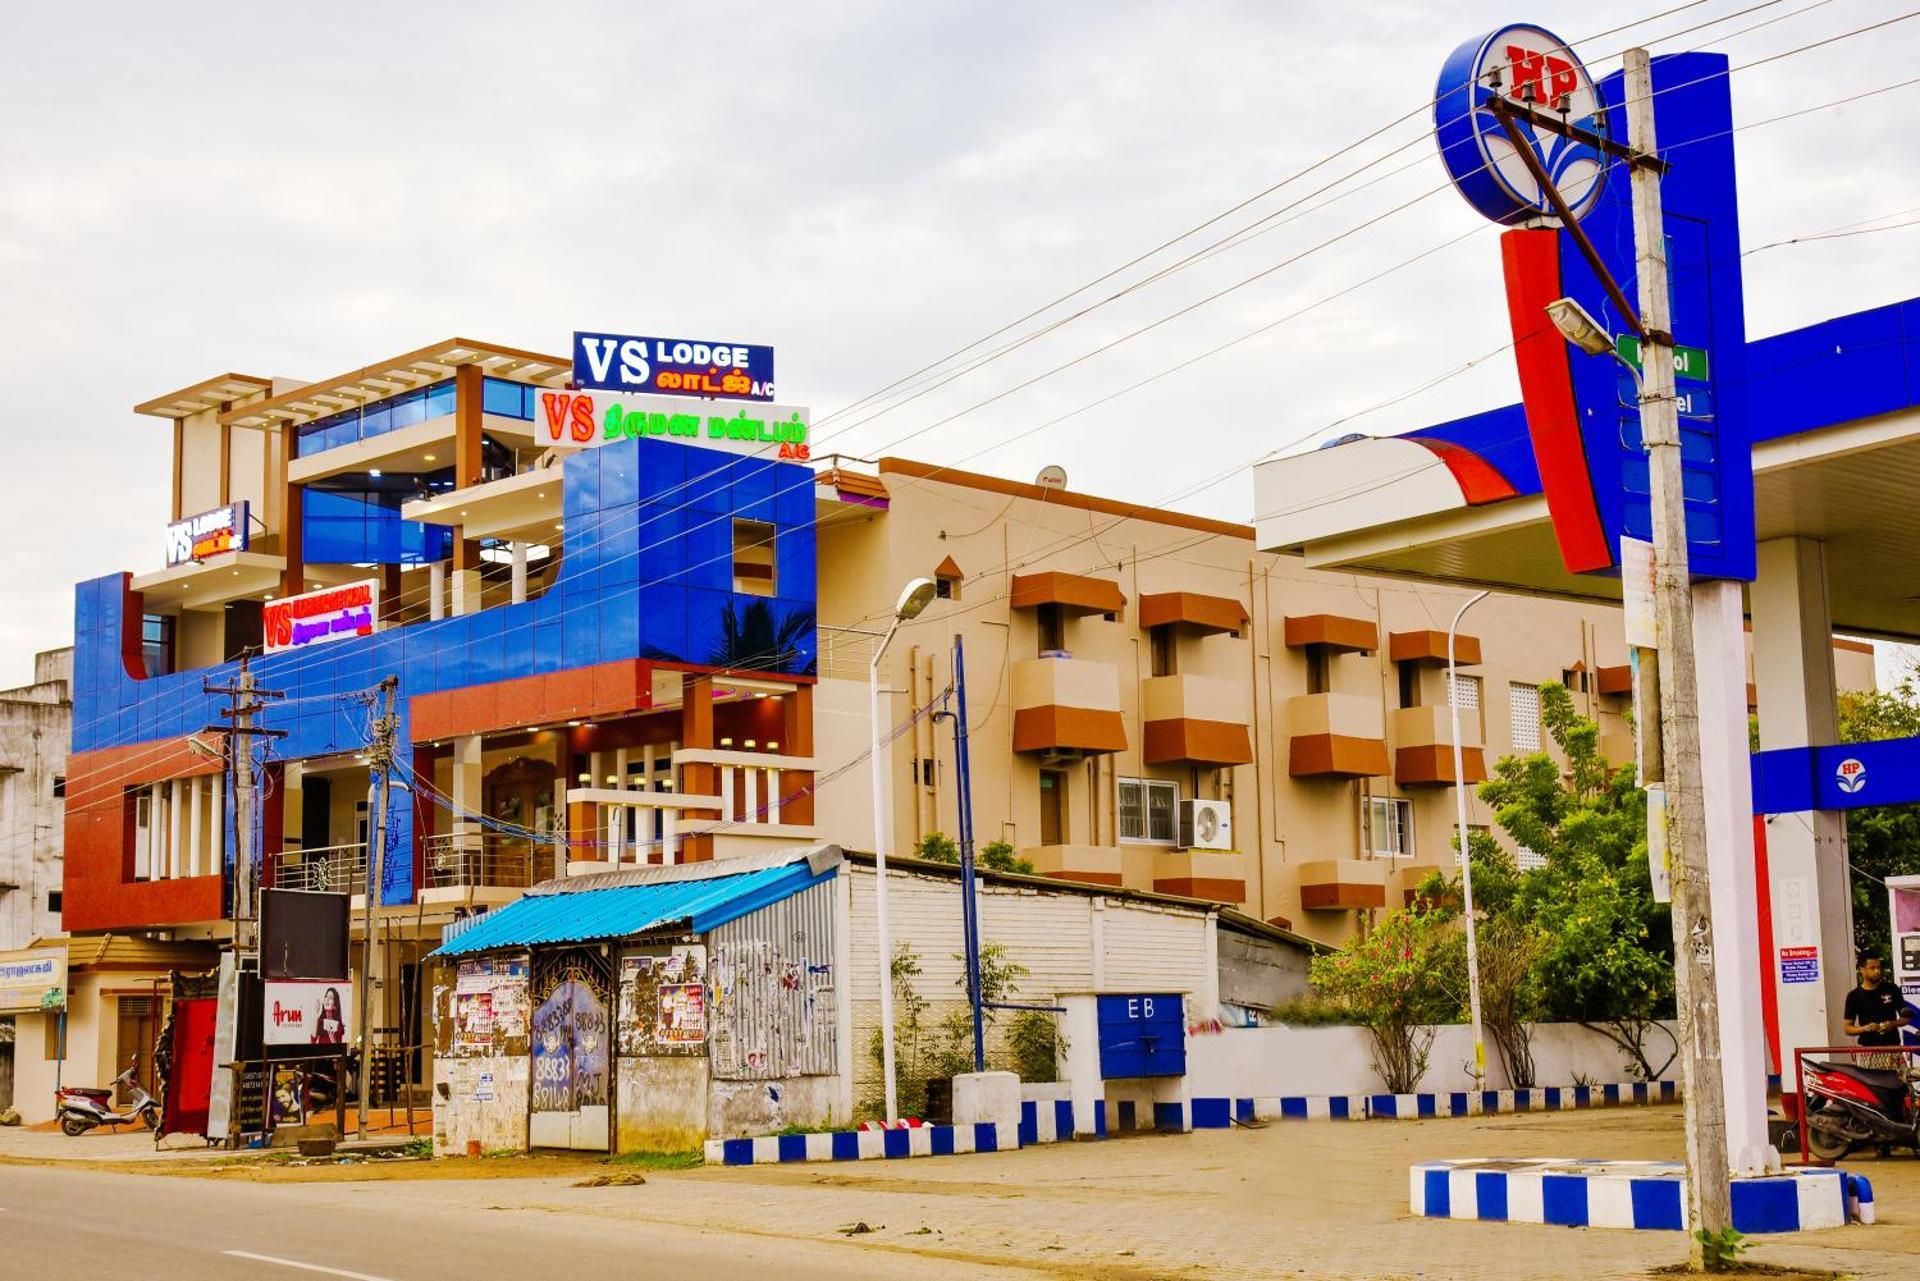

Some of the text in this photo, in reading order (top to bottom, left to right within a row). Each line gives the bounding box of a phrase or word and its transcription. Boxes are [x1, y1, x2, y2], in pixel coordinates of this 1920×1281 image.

[1506, 45, 1577, 111] HP
[582, 338, 749, 384] VS LODGE
[656, 366, 751, 394] லாட்ஜ்
[751, 381, 774, 396] A/C
[542, 392, 806, 443] VS திருமண மண்டபம்
[778, 440, 810, 459] A/C
[167, 521, 193, 563] VS
[263, 603, 292, 648] VS
[1842, 762, 1860, 775] HP
[272, 1000, 303, 1027] Arun
